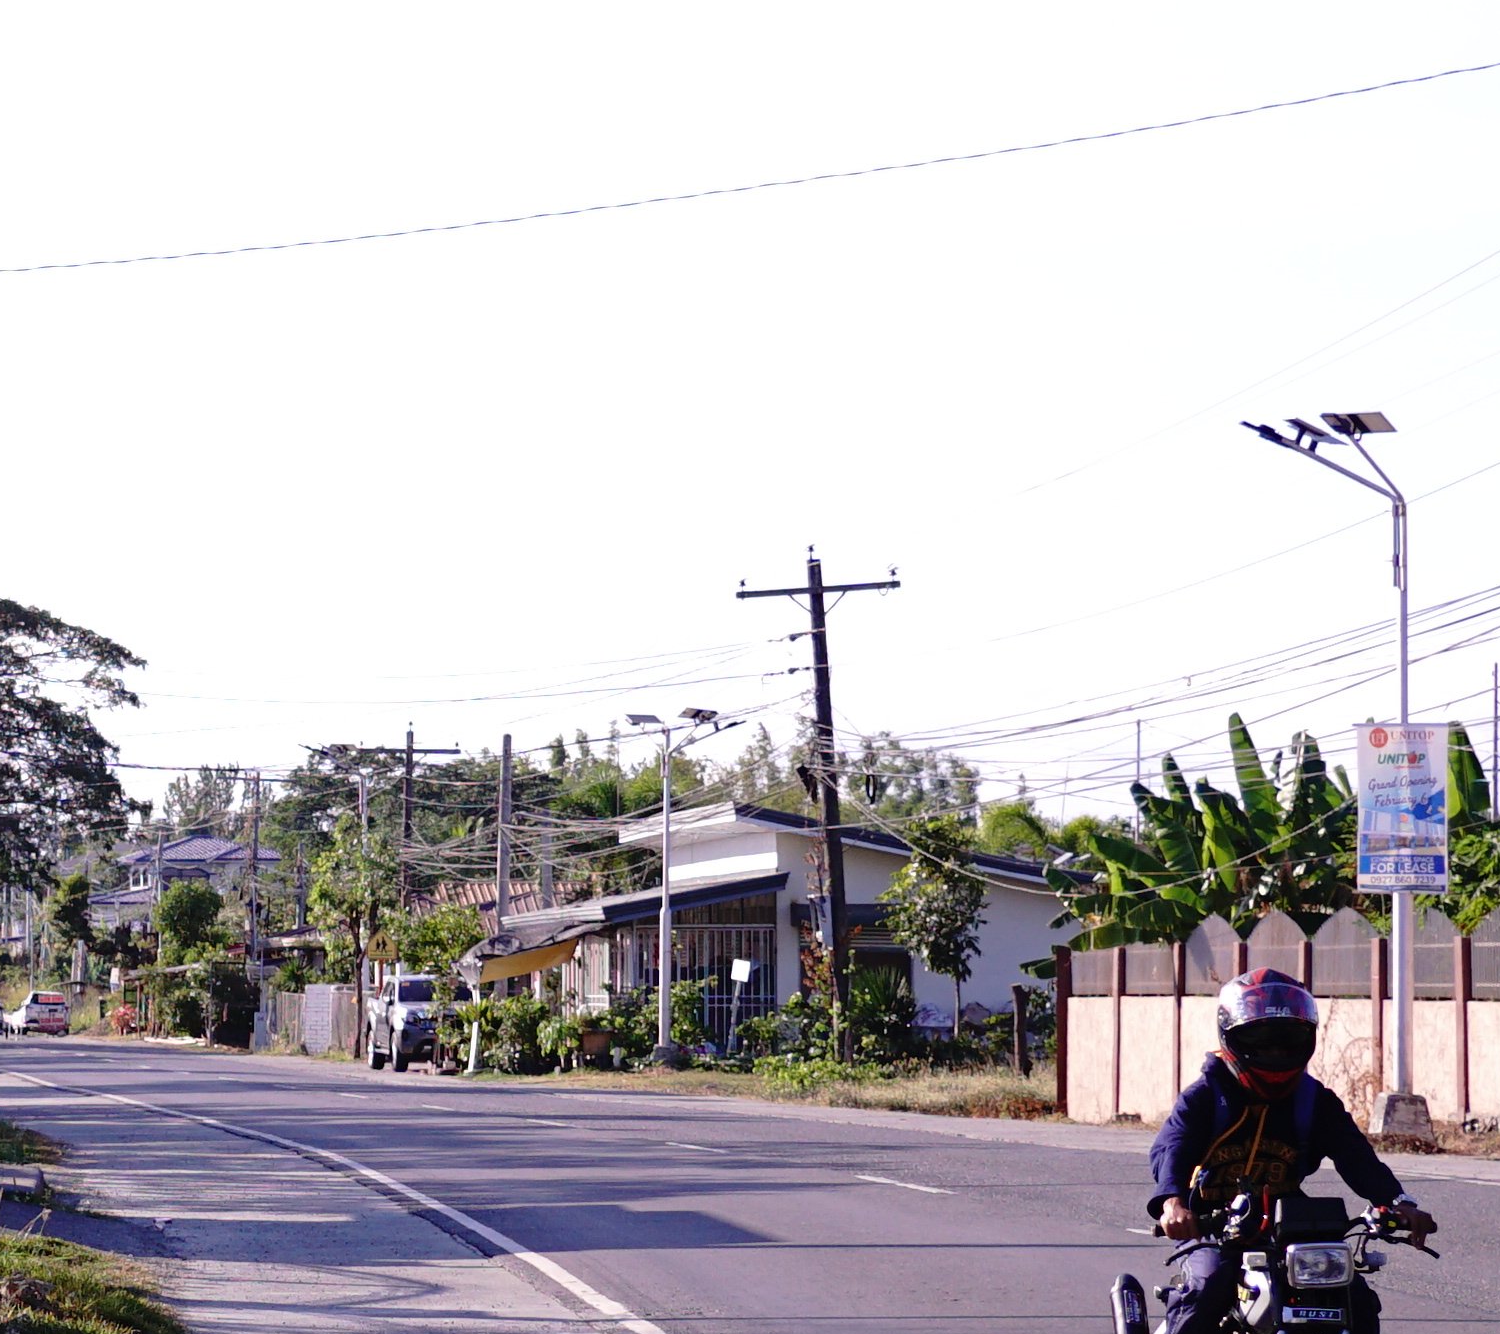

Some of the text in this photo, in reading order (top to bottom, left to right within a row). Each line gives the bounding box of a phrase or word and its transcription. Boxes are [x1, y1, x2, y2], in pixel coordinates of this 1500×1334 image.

[1391, 731, 1434, 740] UNITOP
[1368, 775, 1437, 793] Grand Opening
[1374, 794, 1417, 808] February
[1370, 863, 1435, 873] FOR LEASE
